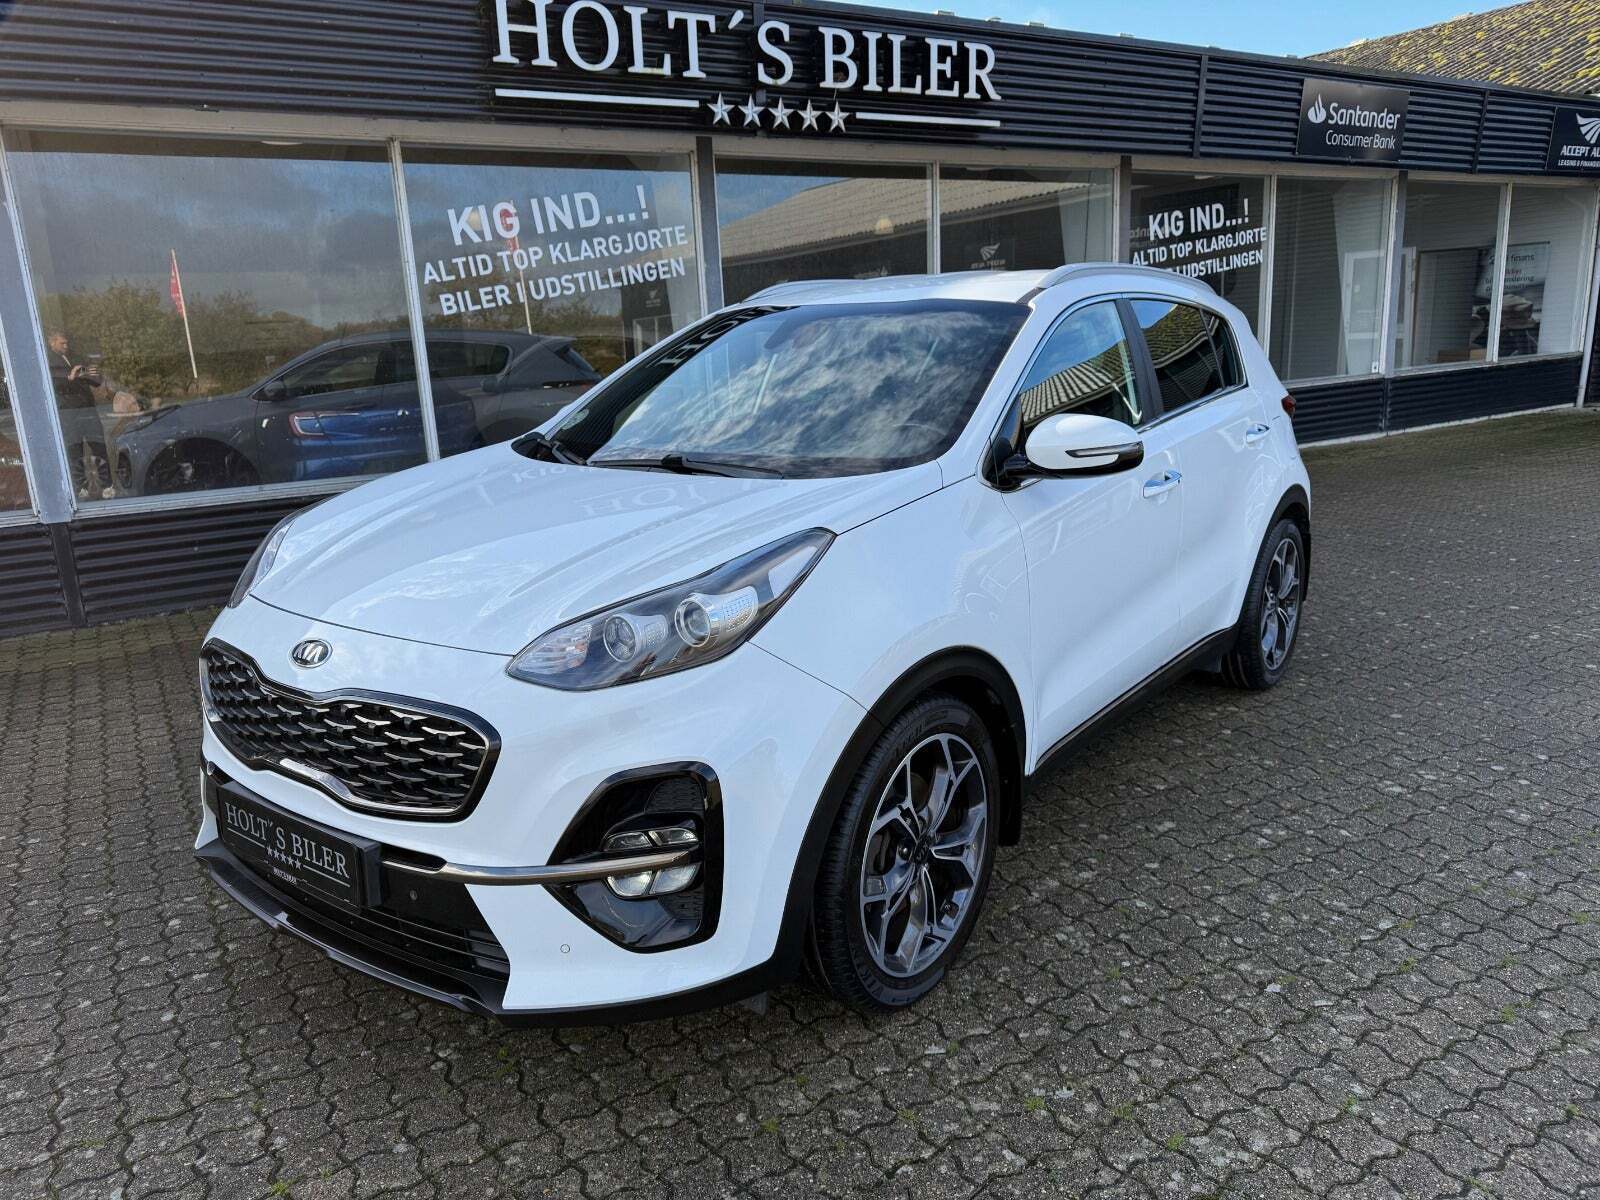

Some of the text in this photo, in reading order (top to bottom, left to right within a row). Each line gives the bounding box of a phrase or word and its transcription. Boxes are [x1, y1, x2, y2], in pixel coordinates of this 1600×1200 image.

[818, 26, 1001, 99] BILER
[1328, 102, 1400, 129] Santander
[1325, 130, 1396, 149] Consumer Bank
[1560, 145, 1590, 157] ACCEPT
[448, 202, 520, 246] KIG
[1148, 210, 1184, 241] KIG
[423, 225, 688, 284] ALTID TOP KLARGJORTE
[1132, 247, 1168, 266] ALTID
[1170, 241, 1193, 260] TOP
[1195, 227, 1267, 255] KLARGJORTE
[1183, 249, 1263, 278] UDSTILLINGEN
[439, 257, 686, 316] BILER I UDSTILLINGEN
[291, 832, 350, 878] BILER
